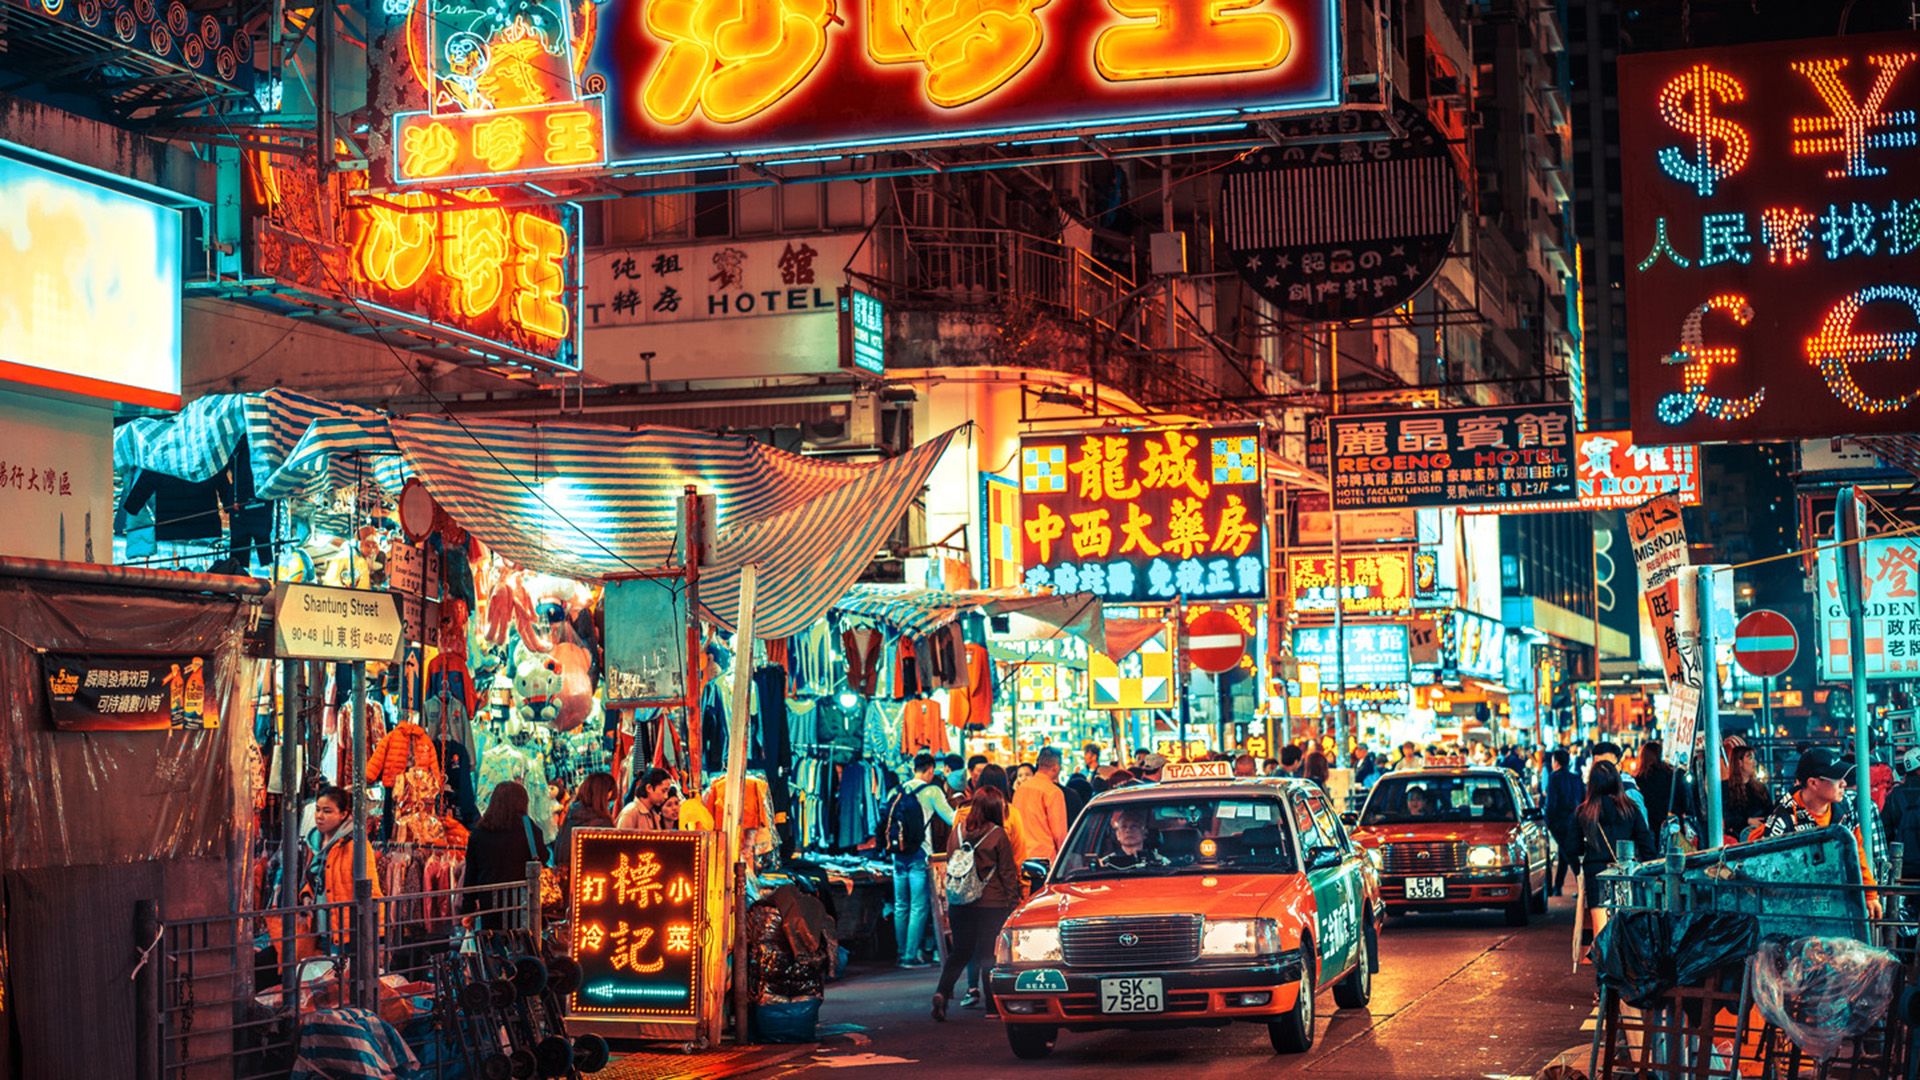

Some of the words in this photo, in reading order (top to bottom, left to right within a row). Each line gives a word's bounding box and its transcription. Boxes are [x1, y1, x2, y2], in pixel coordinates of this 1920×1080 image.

[404, 111, 599, 177] 沙嗲王
[708, 287, 834, 315] HOTEL
[1335, 411, 1568, 457] 麗晶賓館
[1068, 431, 1210, 501] 龍城
[1475, 448, 1567, 467] HOTEL
[1336, 488, 1365, 498] HOTEL
[1600, 473, 1695, 495] HOTEL
[1336, 496, 1365, 506] HOTEL
[1024, 495, 1258, 563] 中西大藥房
[303, 593, 348, 618] Shantung
[350, 597, 379, 617] Street
[1829, 602, 1915, 617] GDEN
[322, 625, 361, 649] 山東街
[1167, 762, 1226, 779] TAXI
[1408, 887, 1442, 898] 3386
[610, 851, 664, 974] 標記
[667, 877, 692, 951] 小菜
[1035, 971, 1046, 983] 4
[1119, 979, 1144, 995] SK
[1106, 994, 1158, 1012] 7520
